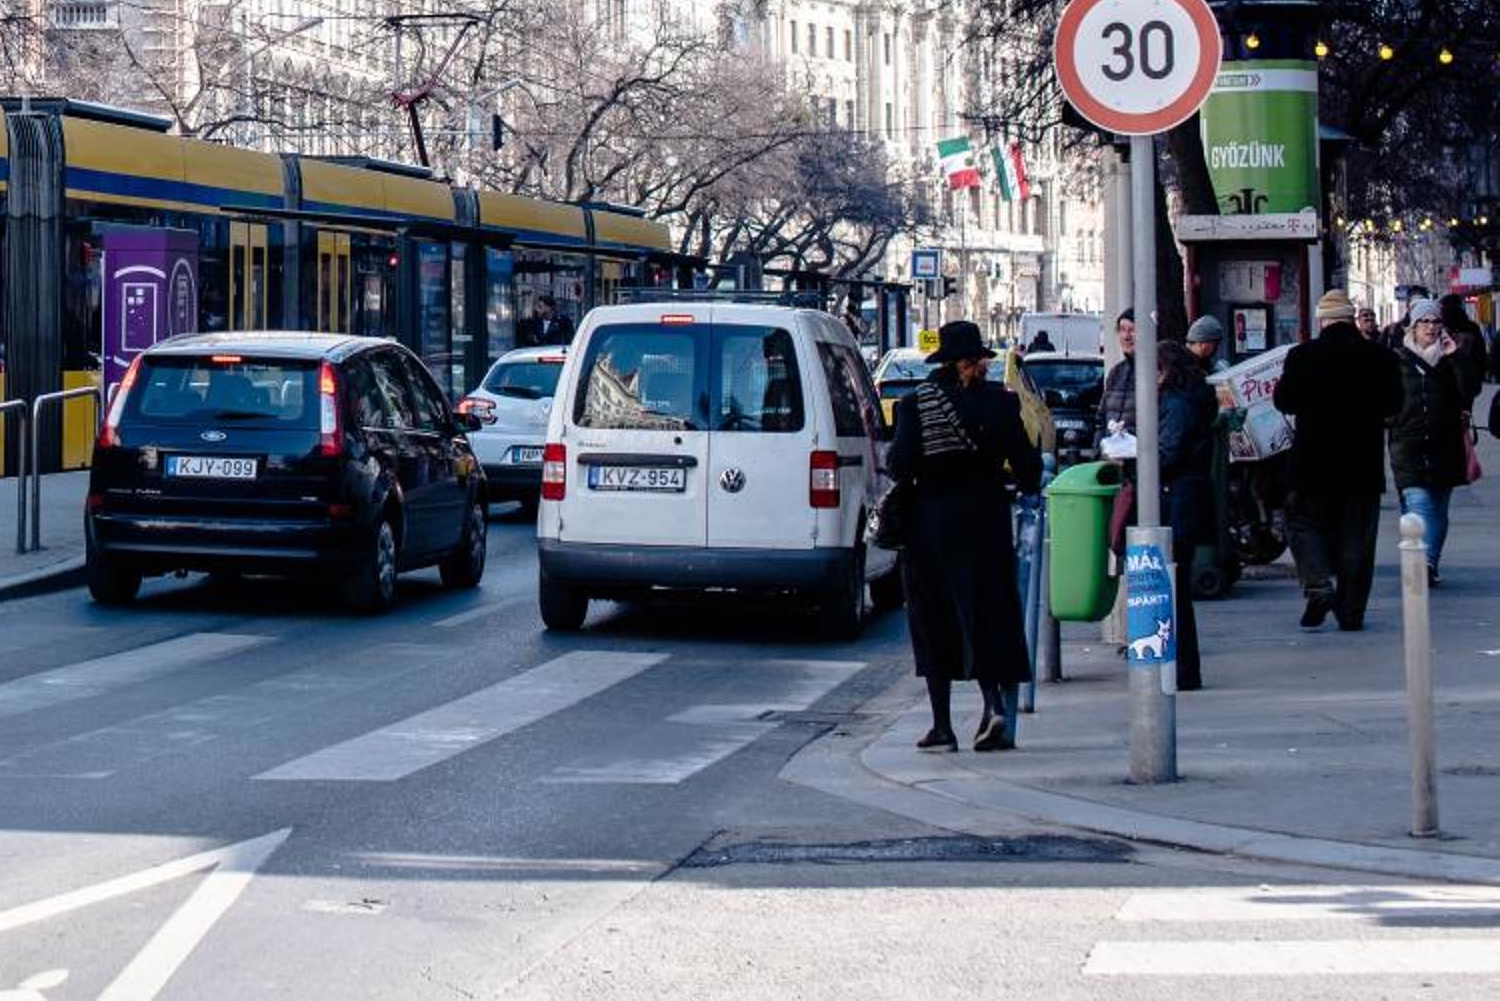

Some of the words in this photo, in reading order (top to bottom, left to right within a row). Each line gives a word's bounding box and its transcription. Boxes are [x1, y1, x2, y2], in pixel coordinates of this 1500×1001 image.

[1102, 20, 1174, 81] 30
[179, 458, 253, 476] KJY-099
[603, 467, 680, 486] KVZ-954
